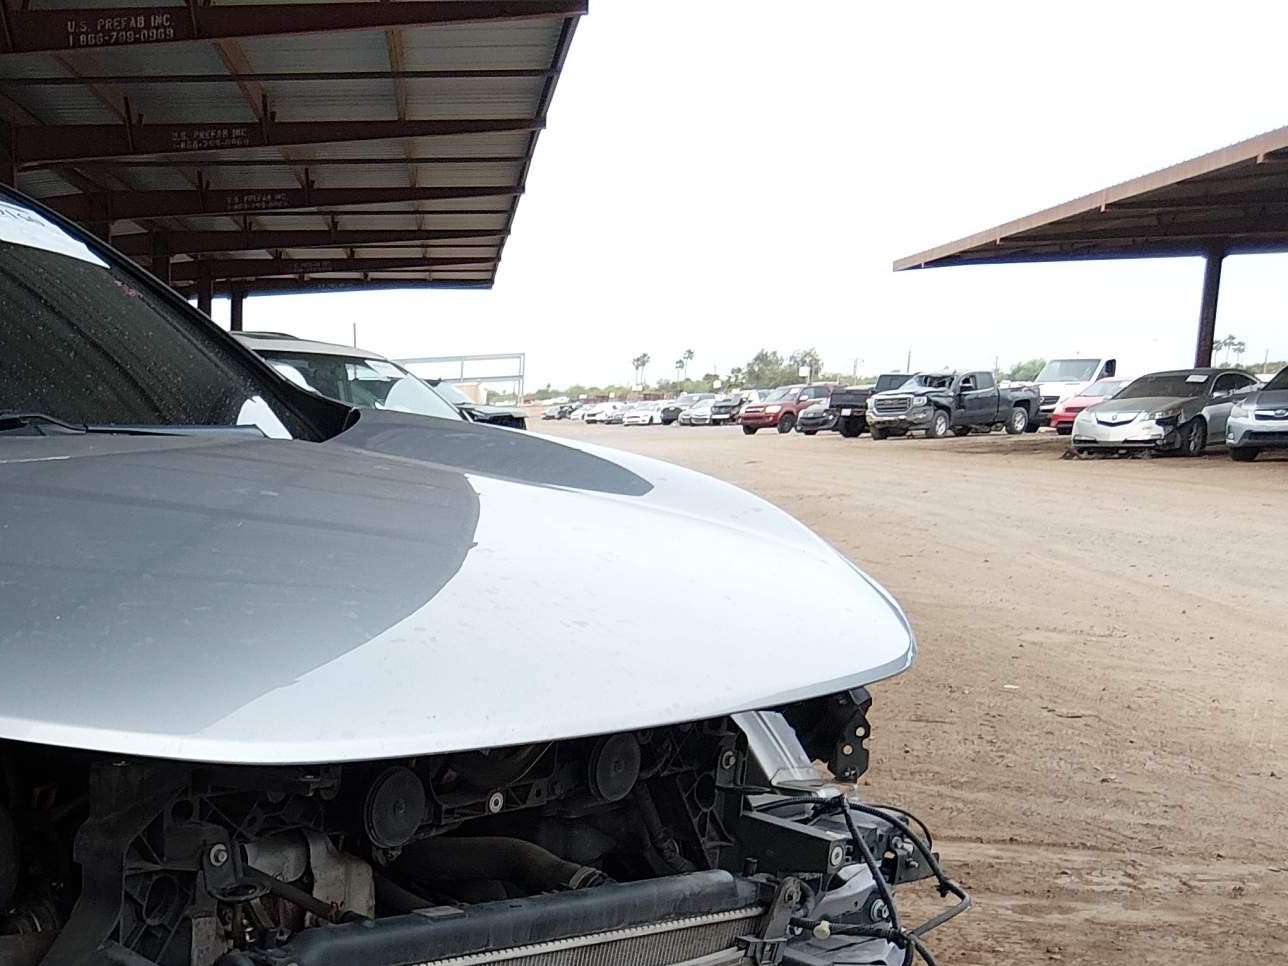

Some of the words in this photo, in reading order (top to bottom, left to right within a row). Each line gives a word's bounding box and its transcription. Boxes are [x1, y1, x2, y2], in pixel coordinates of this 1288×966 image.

[67, 20, 92, 33] U.S.
[97, 15, 147, 31] PREFAB
[150, 13, 178, 27] INC.
